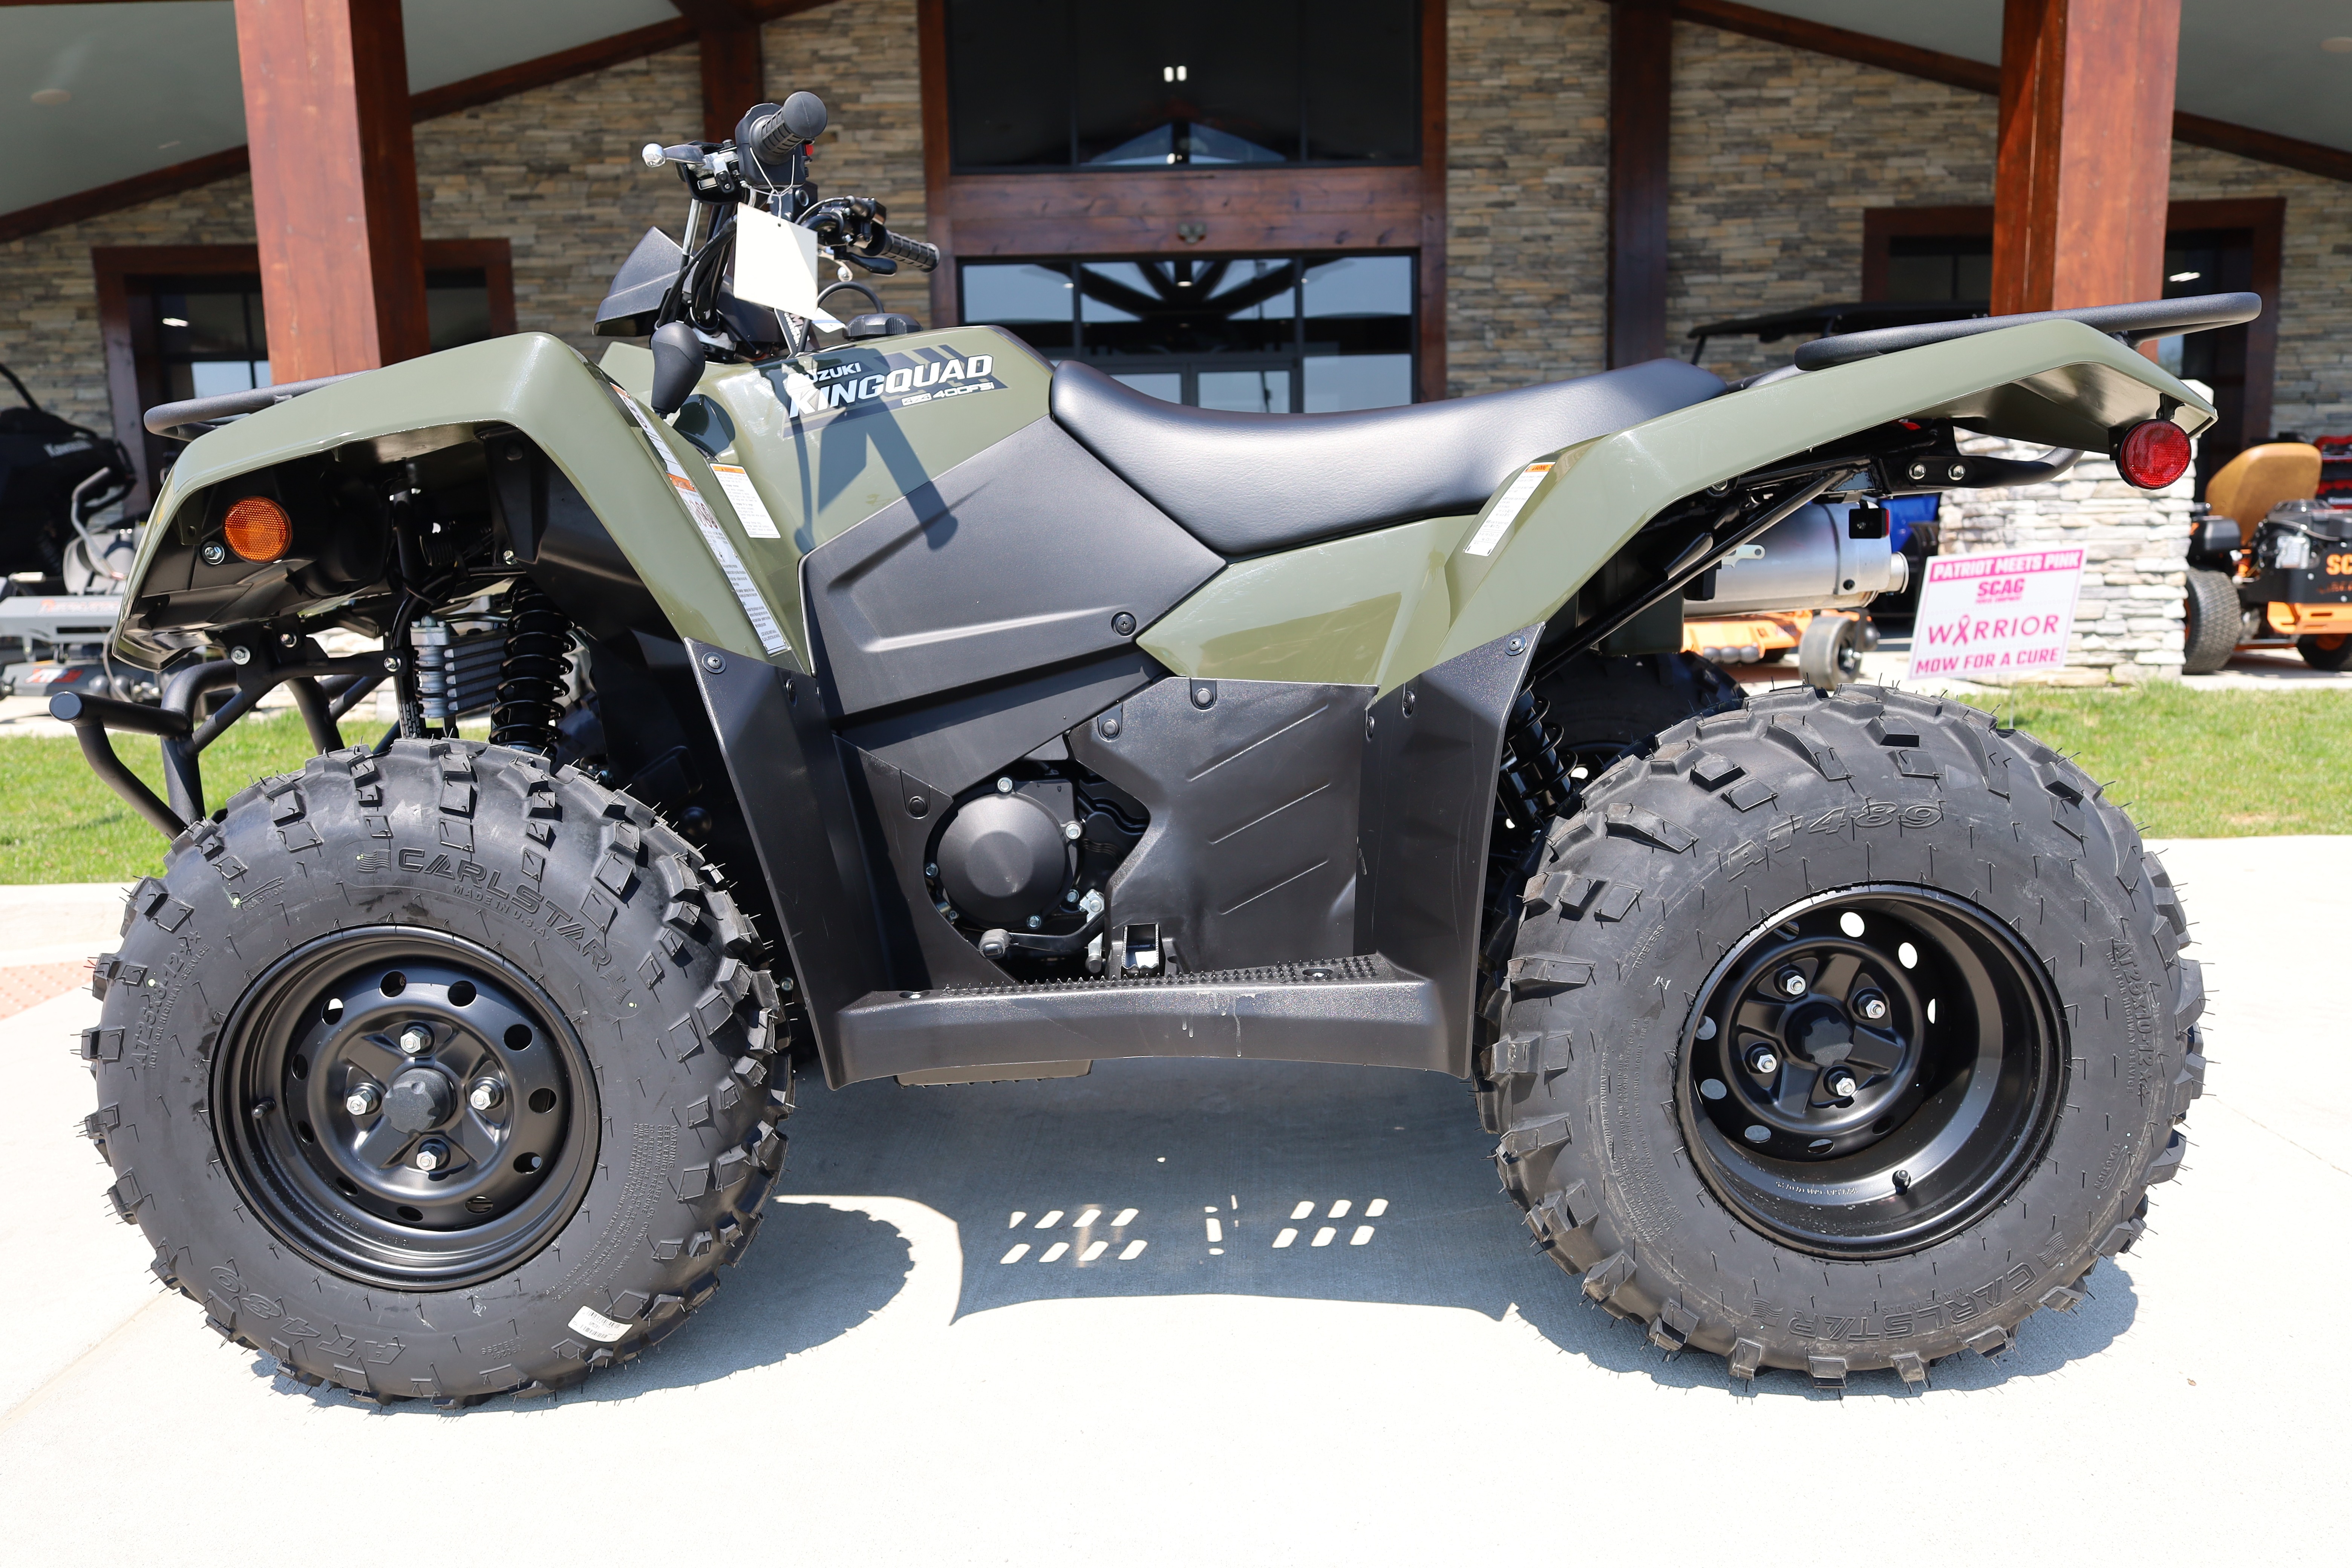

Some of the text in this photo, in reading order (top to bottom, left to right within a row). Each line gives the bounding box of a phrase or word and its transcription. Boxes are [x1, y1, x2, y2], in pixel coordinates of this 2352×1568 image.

[800, 362, 862, 384] UZUKI
[789, 355, 993, 418] KINGQUAD
[933, 382, 995, 398] 400FSI
[1932, 551, 2081, 580] PATRIOT MEETS PINK
[1977, 579, 2025, 596] SCAG
[1916, 648, 2058, 674] MOW FOR A CURE
[1729, 804, 1944, 882] AT489
[241, 884, 287, 913] TRACTION
[397, 848, 616, 974] CARLSTAR
[452, 884, 554, 942] MADE IN U.S.A.
[1631, 924, 1666, 971] TUBELESS
[148, 942, 211, 1069] NOT FOR HIGHWAY SERVICE
[2104, 951, 2138, 1095] NOT FOR HIGHWAY SERVICE
[1634, 1043, 1643, 1069] MOUNT
[1599, 1073, 1608, 1108] MANUAL
[1617, 1105, 1625, 1116] OR
[1623, 1105, 1634, 1135] INFLATE
[1635, 1103, 1645, 1136] PERSONS
[649, 1124, 655, 1134] TO
[1620, 1119, 1631, 1149] SERIOUS
[643, 1140, 649, 1150] TO
[646, 1136, 654, 1164] REDUCE
[653, 1124, 663, 1170] OPERATING
[667, 1125, 677, 1172] WARNING:
[1626, 1151, 1635, 1162] OF
[1628, 1136, 1638, 1152] NOT
[1641, 1139, 1655, 1168] TRAINED
[627, 1144, 637, 1179] SPECIALLY
[632, 1145, 643, 1175] SEATING
[659, 1145, 669, 1178] VEHICLE
[1609, 1151, 1619, 1165] OR
[1633, 1153, 1642, 1164] DO
[2092, 1140, 2122, 1191] TRACTION
[1615, 1167, 1629, 1191] LABEL
[1631, 1164, 1642, 1180] RISK
[616, 1182, 630, 1210] TRAINED
[629, 1193, 638, 1205] DO
[638, 1182, 648, 1199] RISK
[652, 1181, 663, 1205] LABEL
[1639, 1181, 1649, 1194] THE
[1649, 1178, 1668, 1205] SEATING
[1652, 1169, 1673, 1204] SPECIALLY
[624, 1206, 633, 1220] NOT
[634, 1199, 642, 1210] OF
[645, 1207, 655, 1220] OR
[1627, 1193, 1647, 1224] VEHICLE
[1636, 1196, 1665, 1236] OPERATING
[1646, 1196, 1664, 1221] REDUCE
[1658, 1204, 1667, 1214] TO
[1665, 1205, 1681, 1224] WHEN
[1671, 1204, 1685, 1221] ONLY
[600, 1212, 619, 1240] PERSONS
[609, 1221, 626, 1246] INFLATE
[620, 1212, 637, 1239] SERIOUS
[1646, 1225, 1659, 1241] SEE
[1662, 1221, 1672, 1232] TO
[1665, 1215, 1677, 1228] DUE
[612, 1239, 623, 1250] OR
[628, 1222, 649, 1254] OWNER'S
[582, 1240, 601, 1263] SHOULD
[591, 1246, 611, 1269] BEYOND
[600, 1250, 615, 1267] FATAL
[563, 1263, 582, 1282] MOUNT
[607, 1255, 630, 1282] MANUAL
[593, 1282, 608, 1296] FOR
[1783, 1259, 2042, 1342] CARLSTAR
[1924, 1285, 1966, 1307] MADE
[205, 1257, 406, 1366] AT489
[1906, 1299, 1923, 1311] IN
